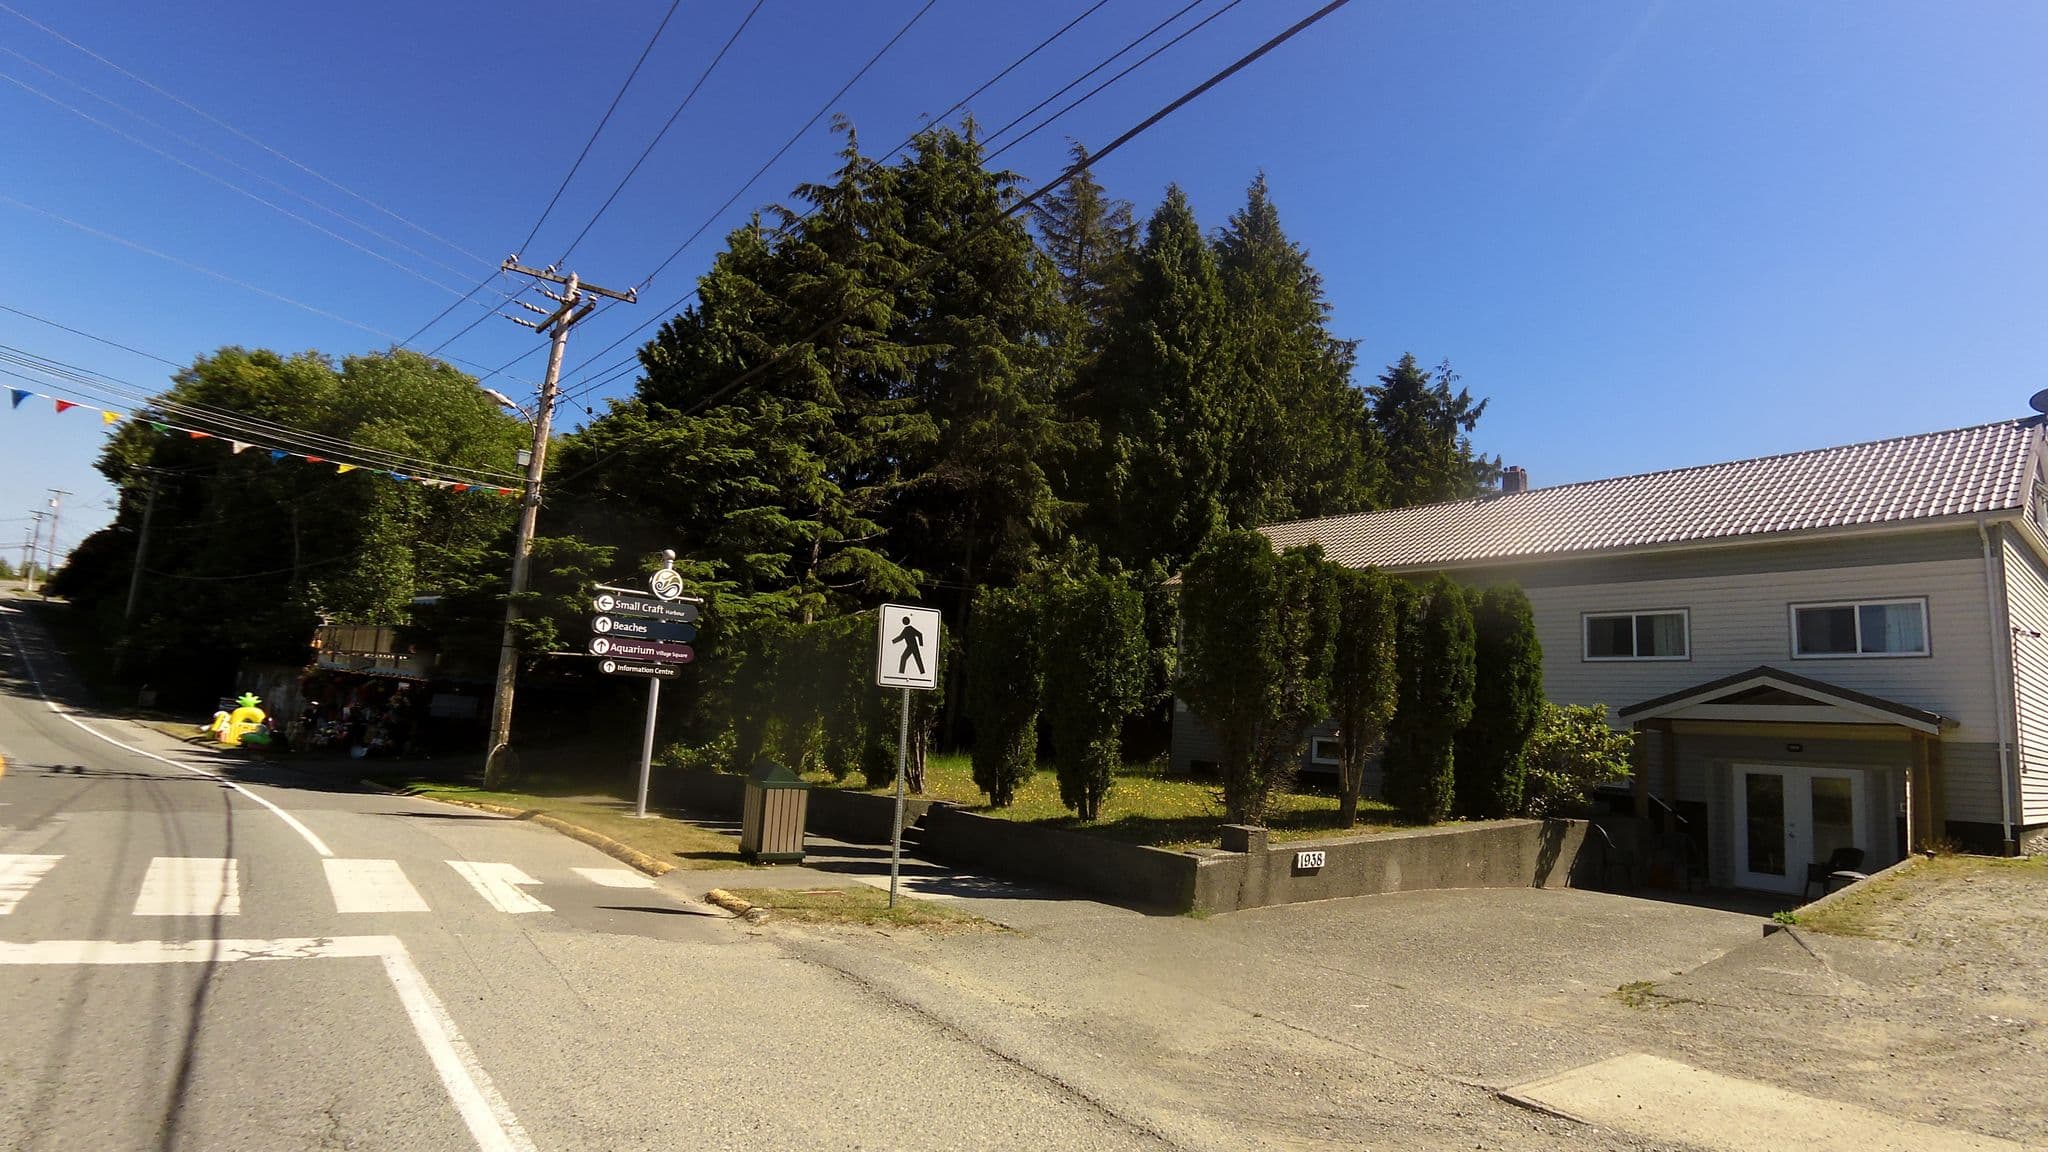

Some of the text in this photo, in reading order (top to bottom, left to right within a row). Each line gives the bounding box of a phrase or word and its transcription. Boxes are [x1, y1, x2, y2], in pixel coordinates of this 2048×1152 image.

[615, 600, 640, 611] Small
[642, 604, 664, 614] Craft
[613, 622, 647, 633] Beaches
[610, 644, 655, 656] Aquarium
[656, 650, 671, 658] Village
[617, 665, 674, 675] Information Centre
[1300, 853, 1323, 867] 1938
